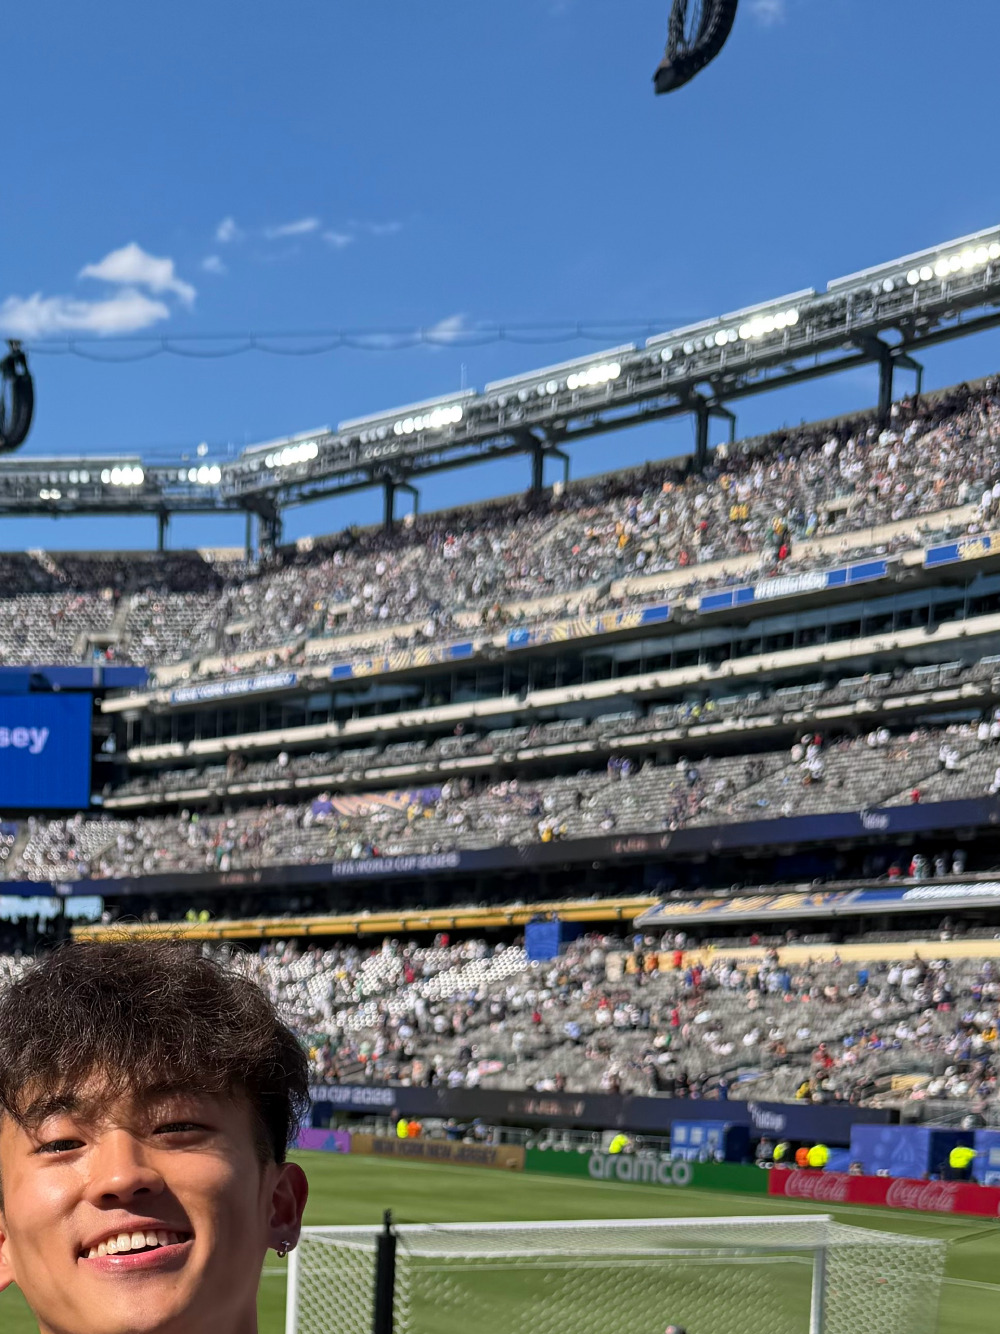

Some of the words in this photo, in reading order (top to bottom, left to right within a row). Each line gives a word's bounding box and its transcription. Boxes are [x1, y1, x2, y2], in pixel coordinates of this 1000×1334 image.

[327, 1086, 351, 1102] CUP
[352, 1087, 396, 1106] 2026
[588, 1155, 694, 1186] aramco
[785, 1170, 850, 1201] Coca-Cola
[886, 1179, 959, 1211] Coca-Cola
